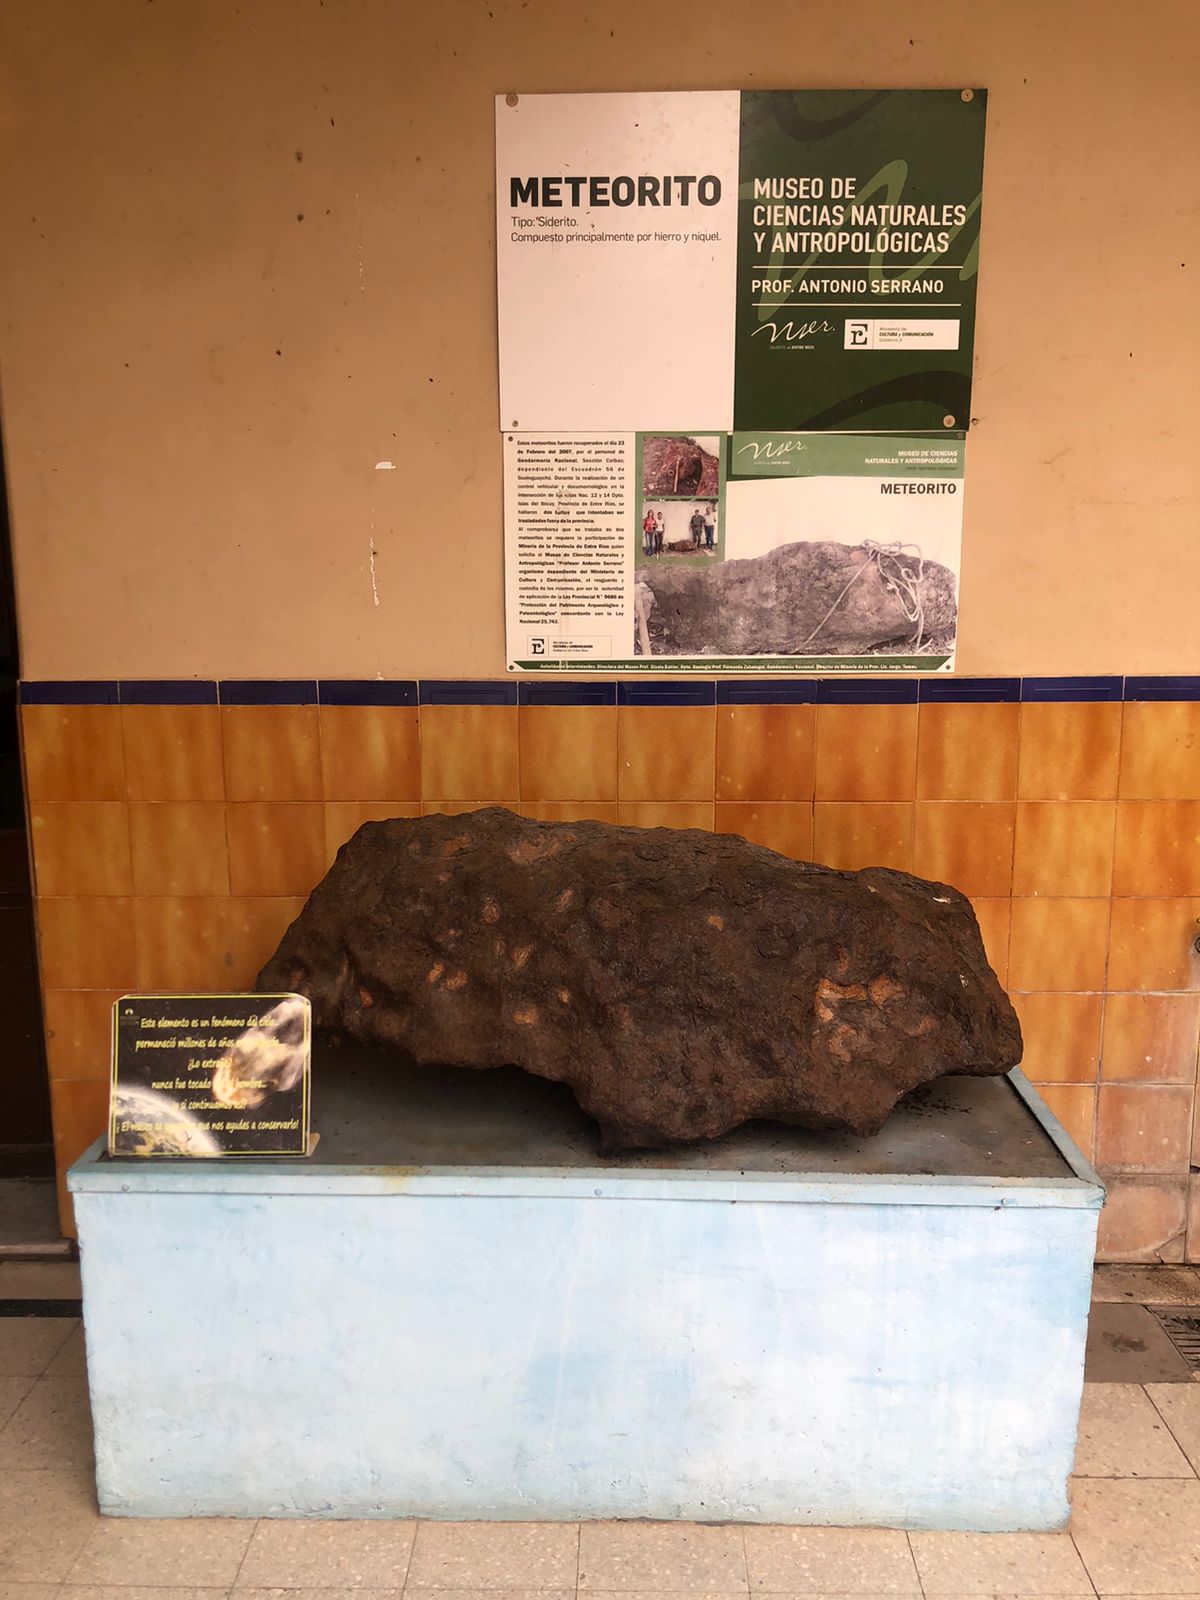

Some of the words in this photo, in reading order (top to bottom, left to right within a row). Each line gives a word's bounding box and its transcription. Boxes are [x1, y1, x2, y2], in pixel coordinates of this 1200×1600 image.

[510, 175, 721, 207] METEORITO
[753, 178, 824, 199] MUSEO
[831, 178, 856, 199] DE
[538, 216, 579, 227] Siderito.
[753, 205, 844, 226] CIENCIAS
[851, 205, 966, 226] NATURALES
[511, 232, 563, 242] Compuesto
[566, 232, 633, 242] principalmente
[655, 231, 680, 240] hierro
[684, 234, 689, 243] y
[753, 232, 766, 253] Y
[771, 228, 949, 253] ANTROPOLÓGICAS
[751, 280, 794, 293] PROF.
[799, 280, 867, 293] ANTONIO
[872, 280, 943, 293] SERRANO
[880, 484, 956, 494] METEORITO
